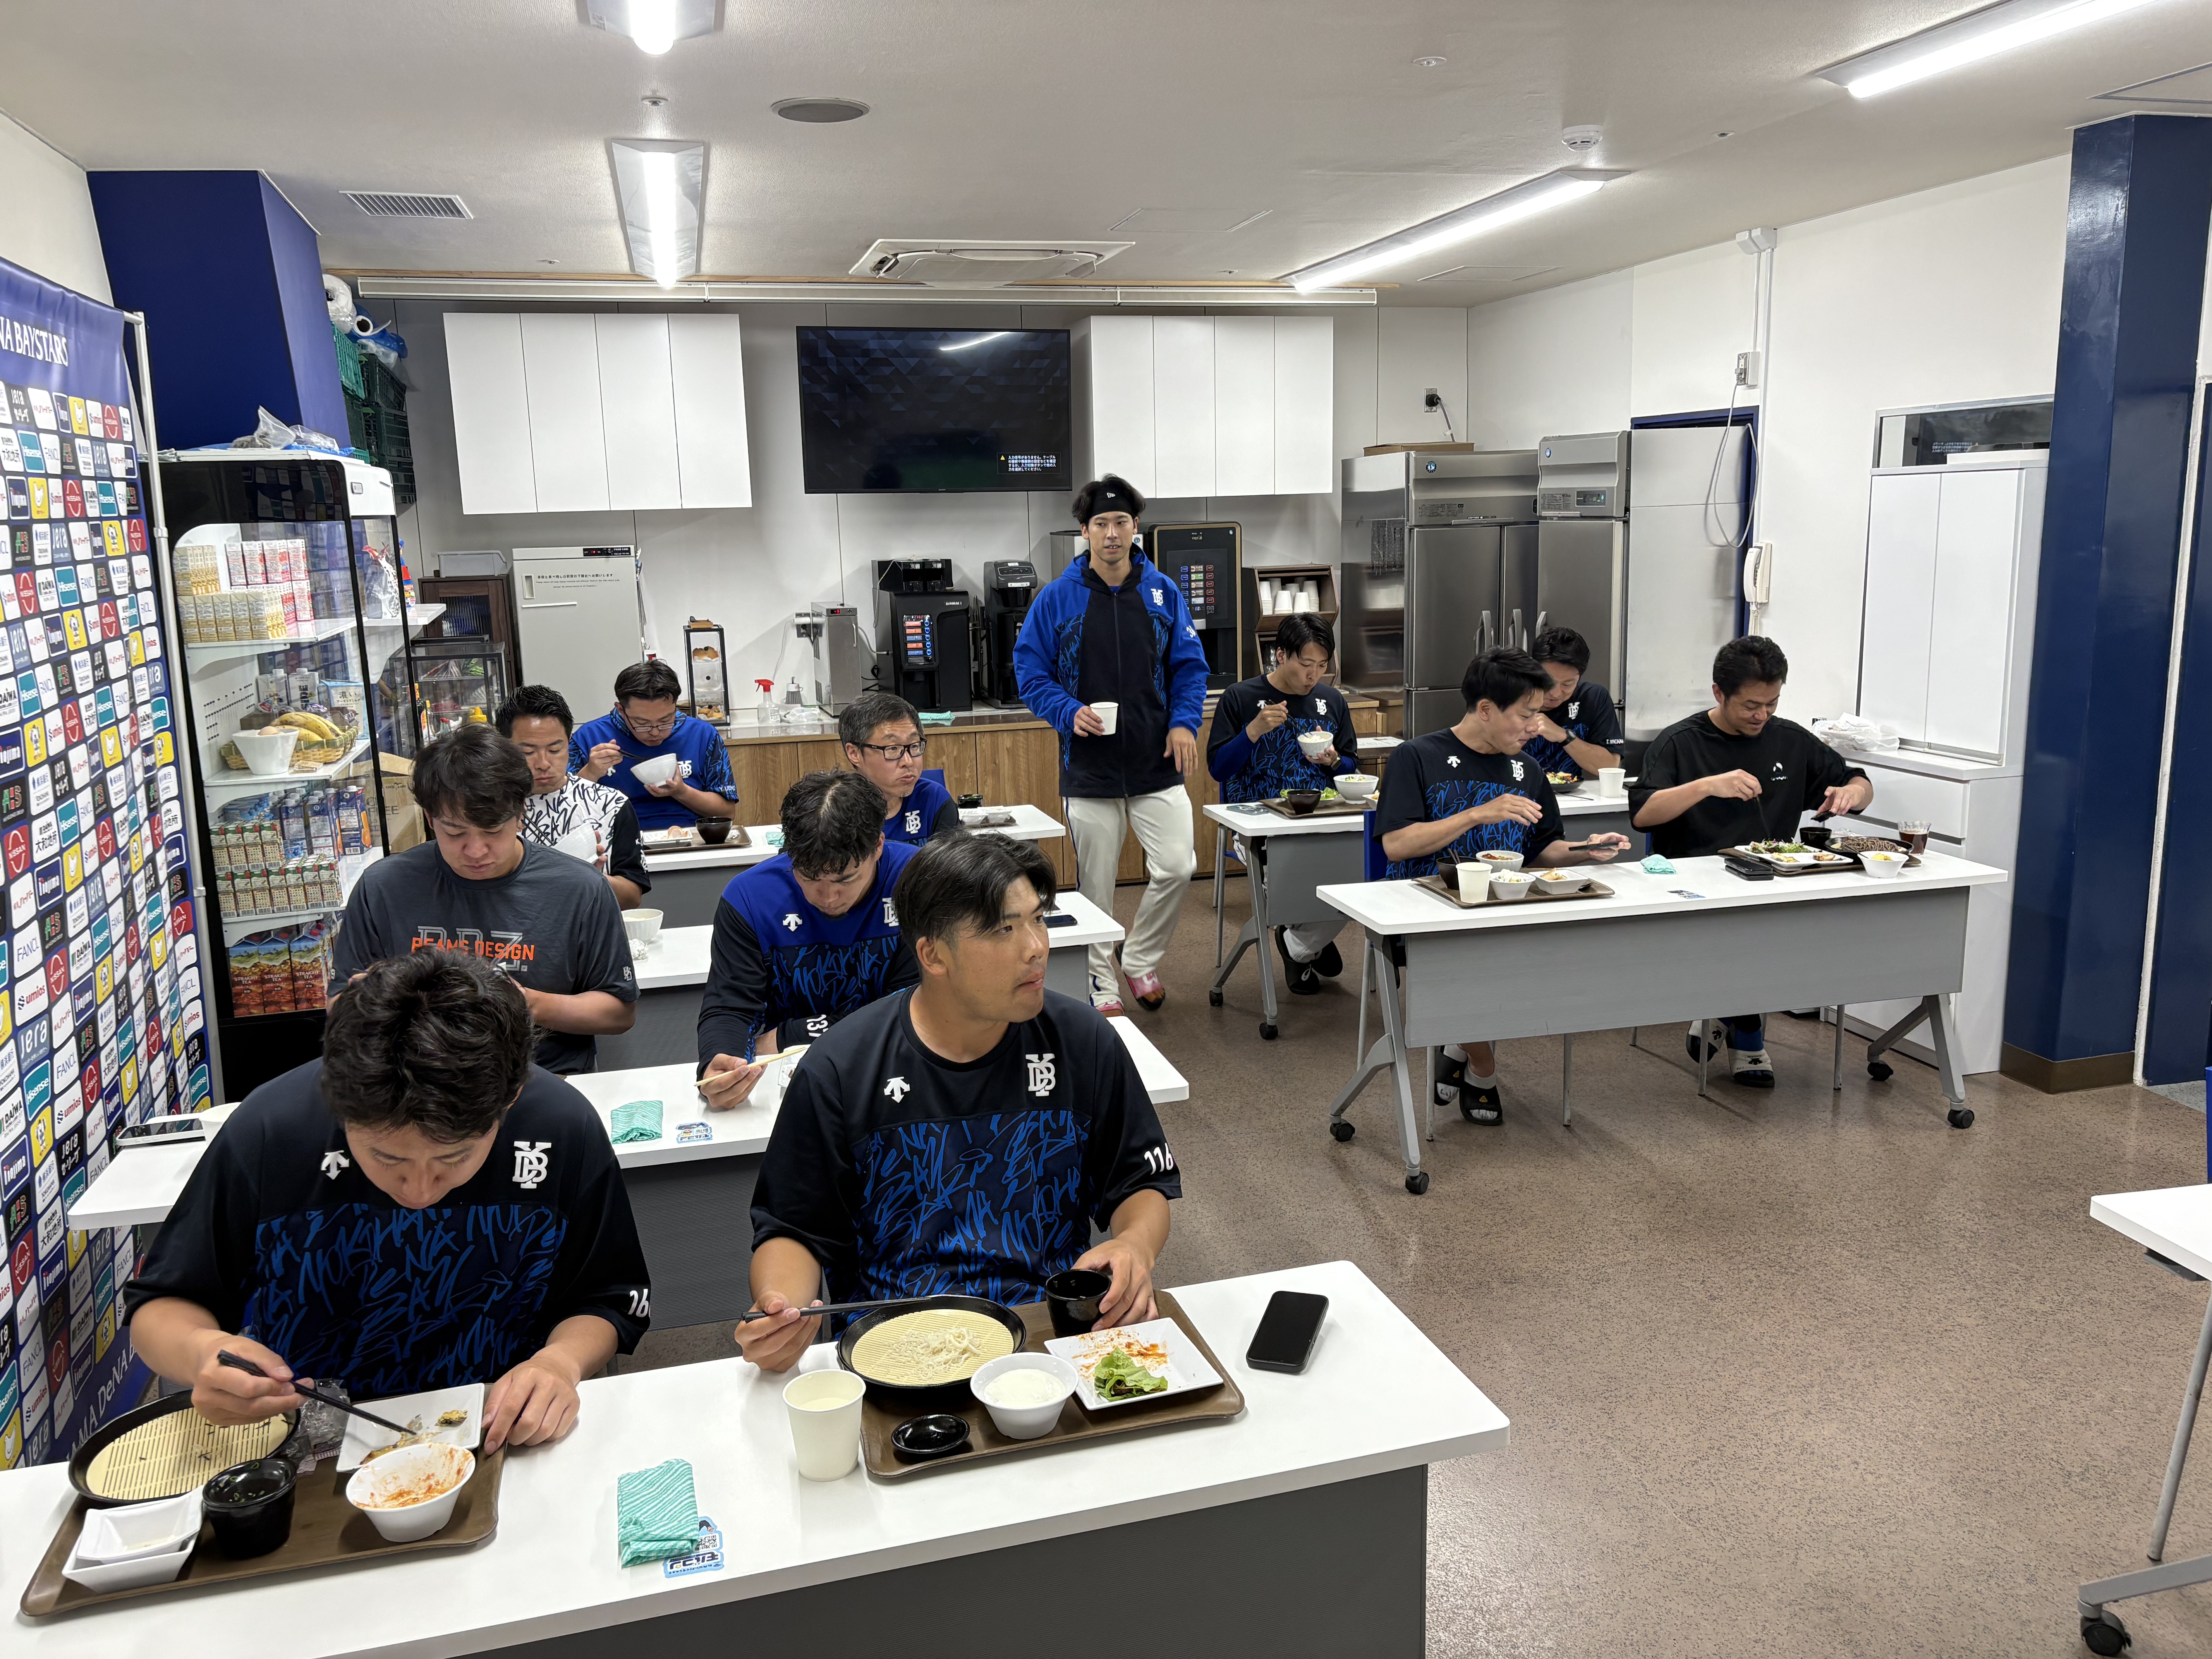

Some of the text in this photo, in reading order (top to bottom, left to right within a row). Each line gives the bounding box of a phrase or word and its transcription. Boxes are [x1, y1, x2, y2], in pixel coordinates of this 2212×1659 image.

[14, 321, 68, 367] BAYSTARS
[17, 936, 40, 962] FANCL
[474, 940, 535, 961] DESIGN
[26, 985, 46, 1005] umios
[57, 1052, 77, 1079] FANCL
[26, 1077, 50, 1105] Hisense
[64, 1097, 81, 1118] umios
[90, 1155, 109, 1182] FANCL
[1144, 1142, 1174, 1175] 116
[0, 1379, 17, 1413] isense
[98, 1348, 128, 1419] DeNA
[31, 1384, 48, 1414] umios
